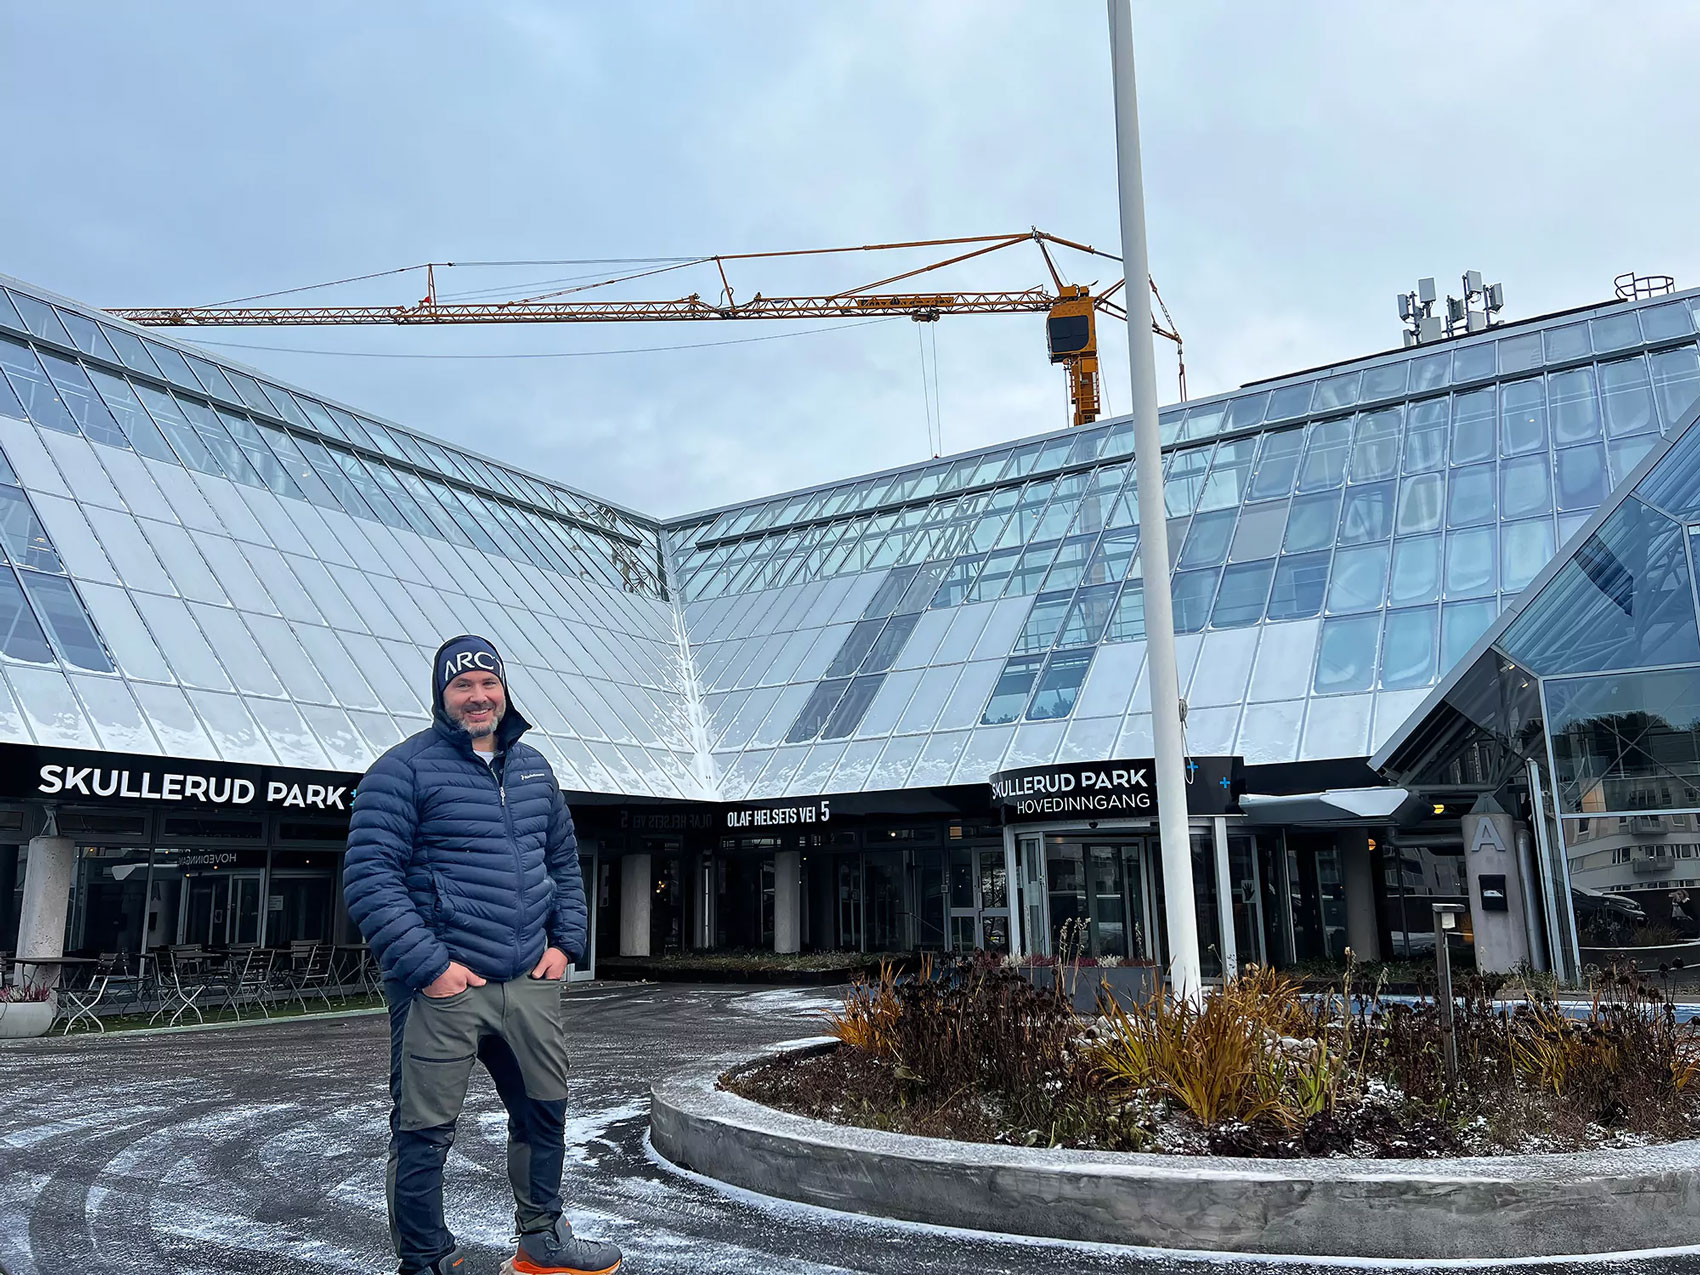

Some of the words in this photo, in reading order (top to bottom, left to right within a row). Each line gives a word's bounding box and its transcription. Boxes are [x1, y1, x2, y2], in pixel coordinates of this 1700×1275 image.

[445, 651, 502, 681] ARC
[38, 765, 255, 804] SKULLERUD
[267, 781, 347, 810] PARK
[992, 773, 1076, 800] SKULLERUD
[1081, 768, 1148, 790] PARK
[727, 811, 752, 827] OLAF
[754, 808, 797, 825] HELSETS
[799, 806, 816, 823] VEI
[820, 800, 830, 822] 5
[1017, 793, 1150, 814] HOVEDINNGANG
[1471, 816, 1506, 852] A
